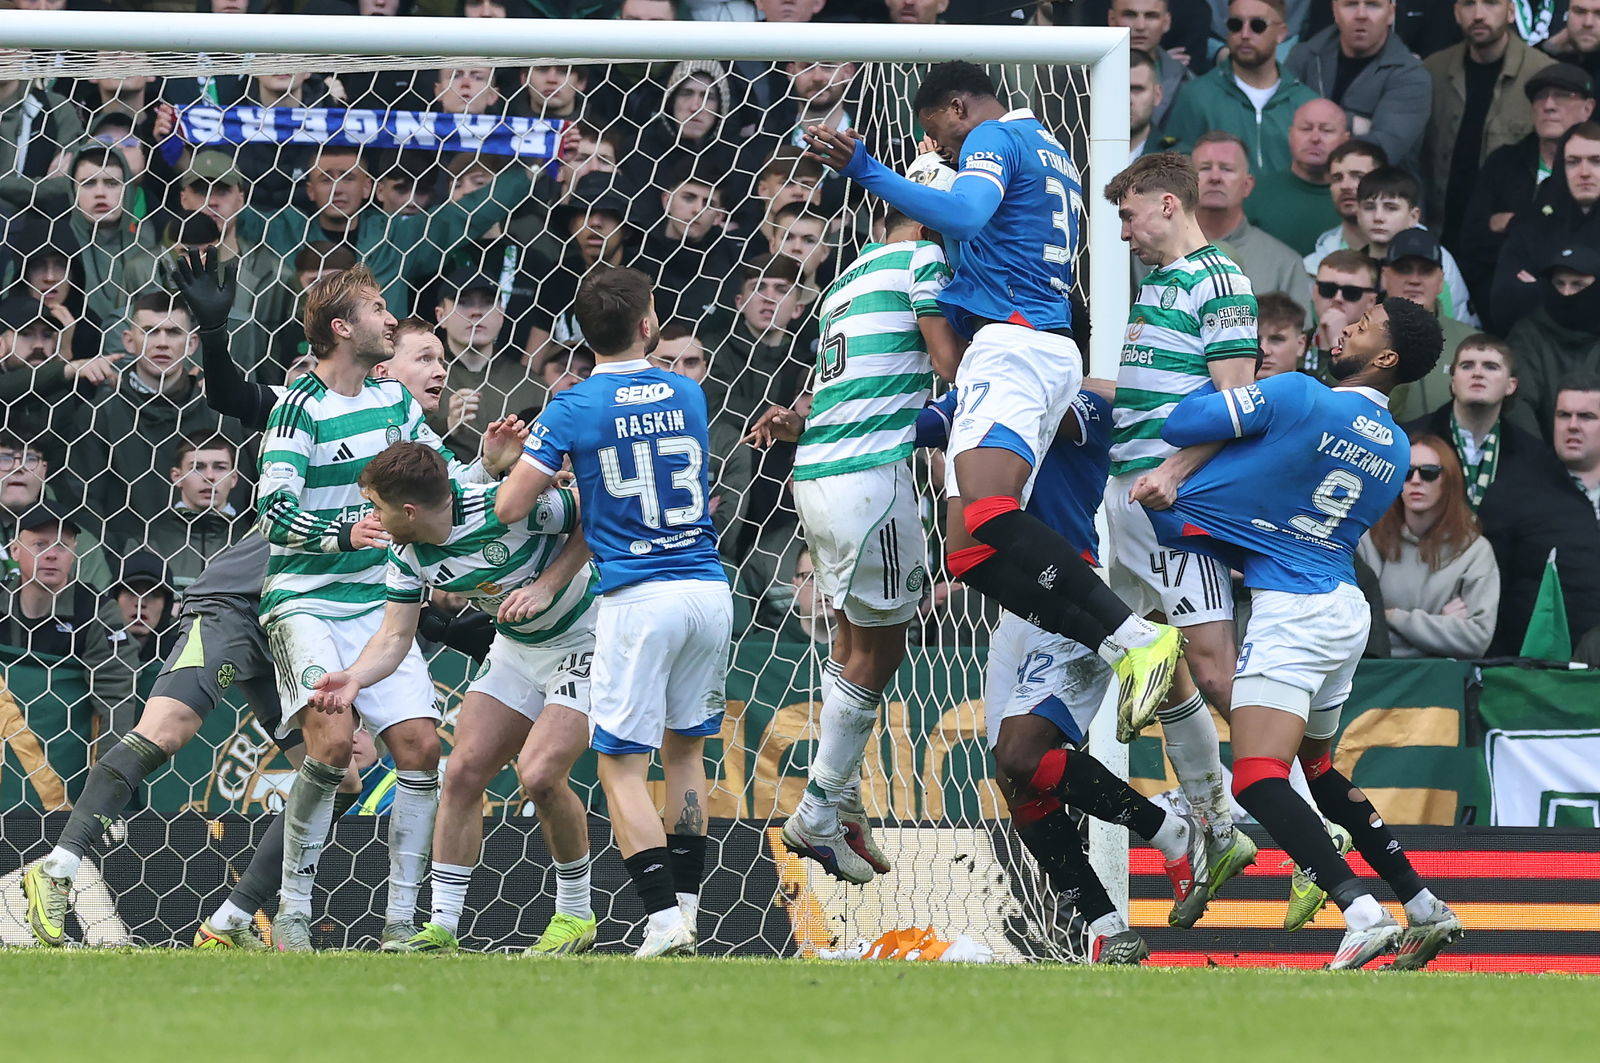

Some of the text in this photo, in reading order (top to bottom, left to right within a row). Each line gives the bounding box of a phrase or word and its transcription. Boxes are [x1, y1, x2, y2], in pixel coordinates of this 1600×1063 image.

[187, 107, 549, 155] RANGERS
[1217, 306, 1241, 319] CELTIC
[820, 299, 851, 383] 6
[614, 382, 675, 403] SEKO
[1077, 393, 1100, 421] OXT
[1247, 383, 1266, 406] OXT
[614, 409, 686, 439] RASKIN
[1352, 415, 1394, 445] SEKO
[1316, 431, 1396, 485] Y.CHERMITI
[597, 435, 702, 529] 43
[1287, 468, 1364, 539] 9
[1150, 549, 1189, 588] 47
